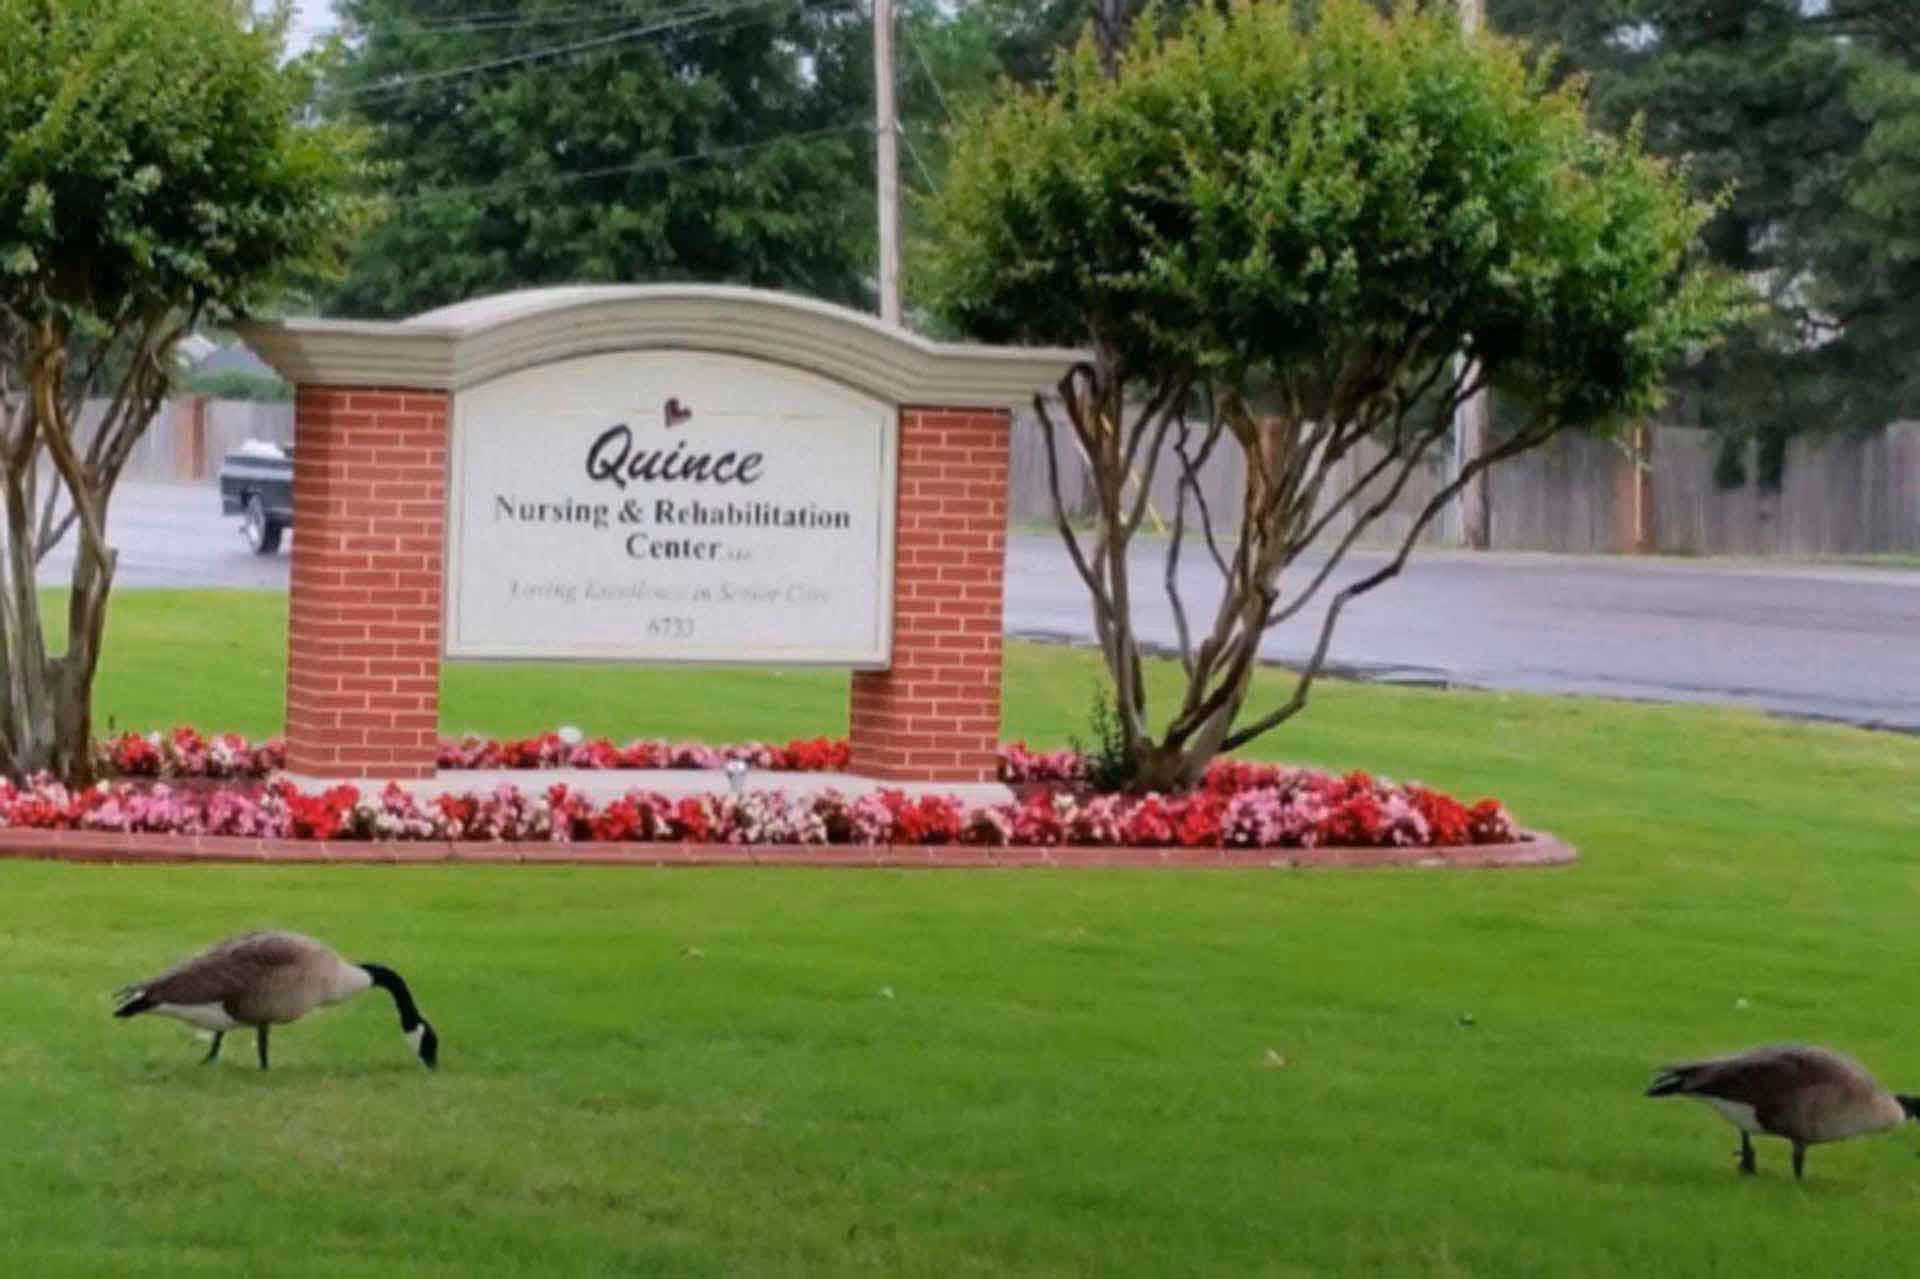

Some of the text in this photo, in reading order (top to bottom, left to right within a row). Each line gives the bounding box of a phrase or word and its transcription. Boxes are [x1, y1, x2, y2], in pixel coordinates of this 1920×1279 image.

[586, 423, 764, 491] Quince
[495, 494, 850, 530] Nursing & Rehabilitation
[626, 532, 721, 560] Center
